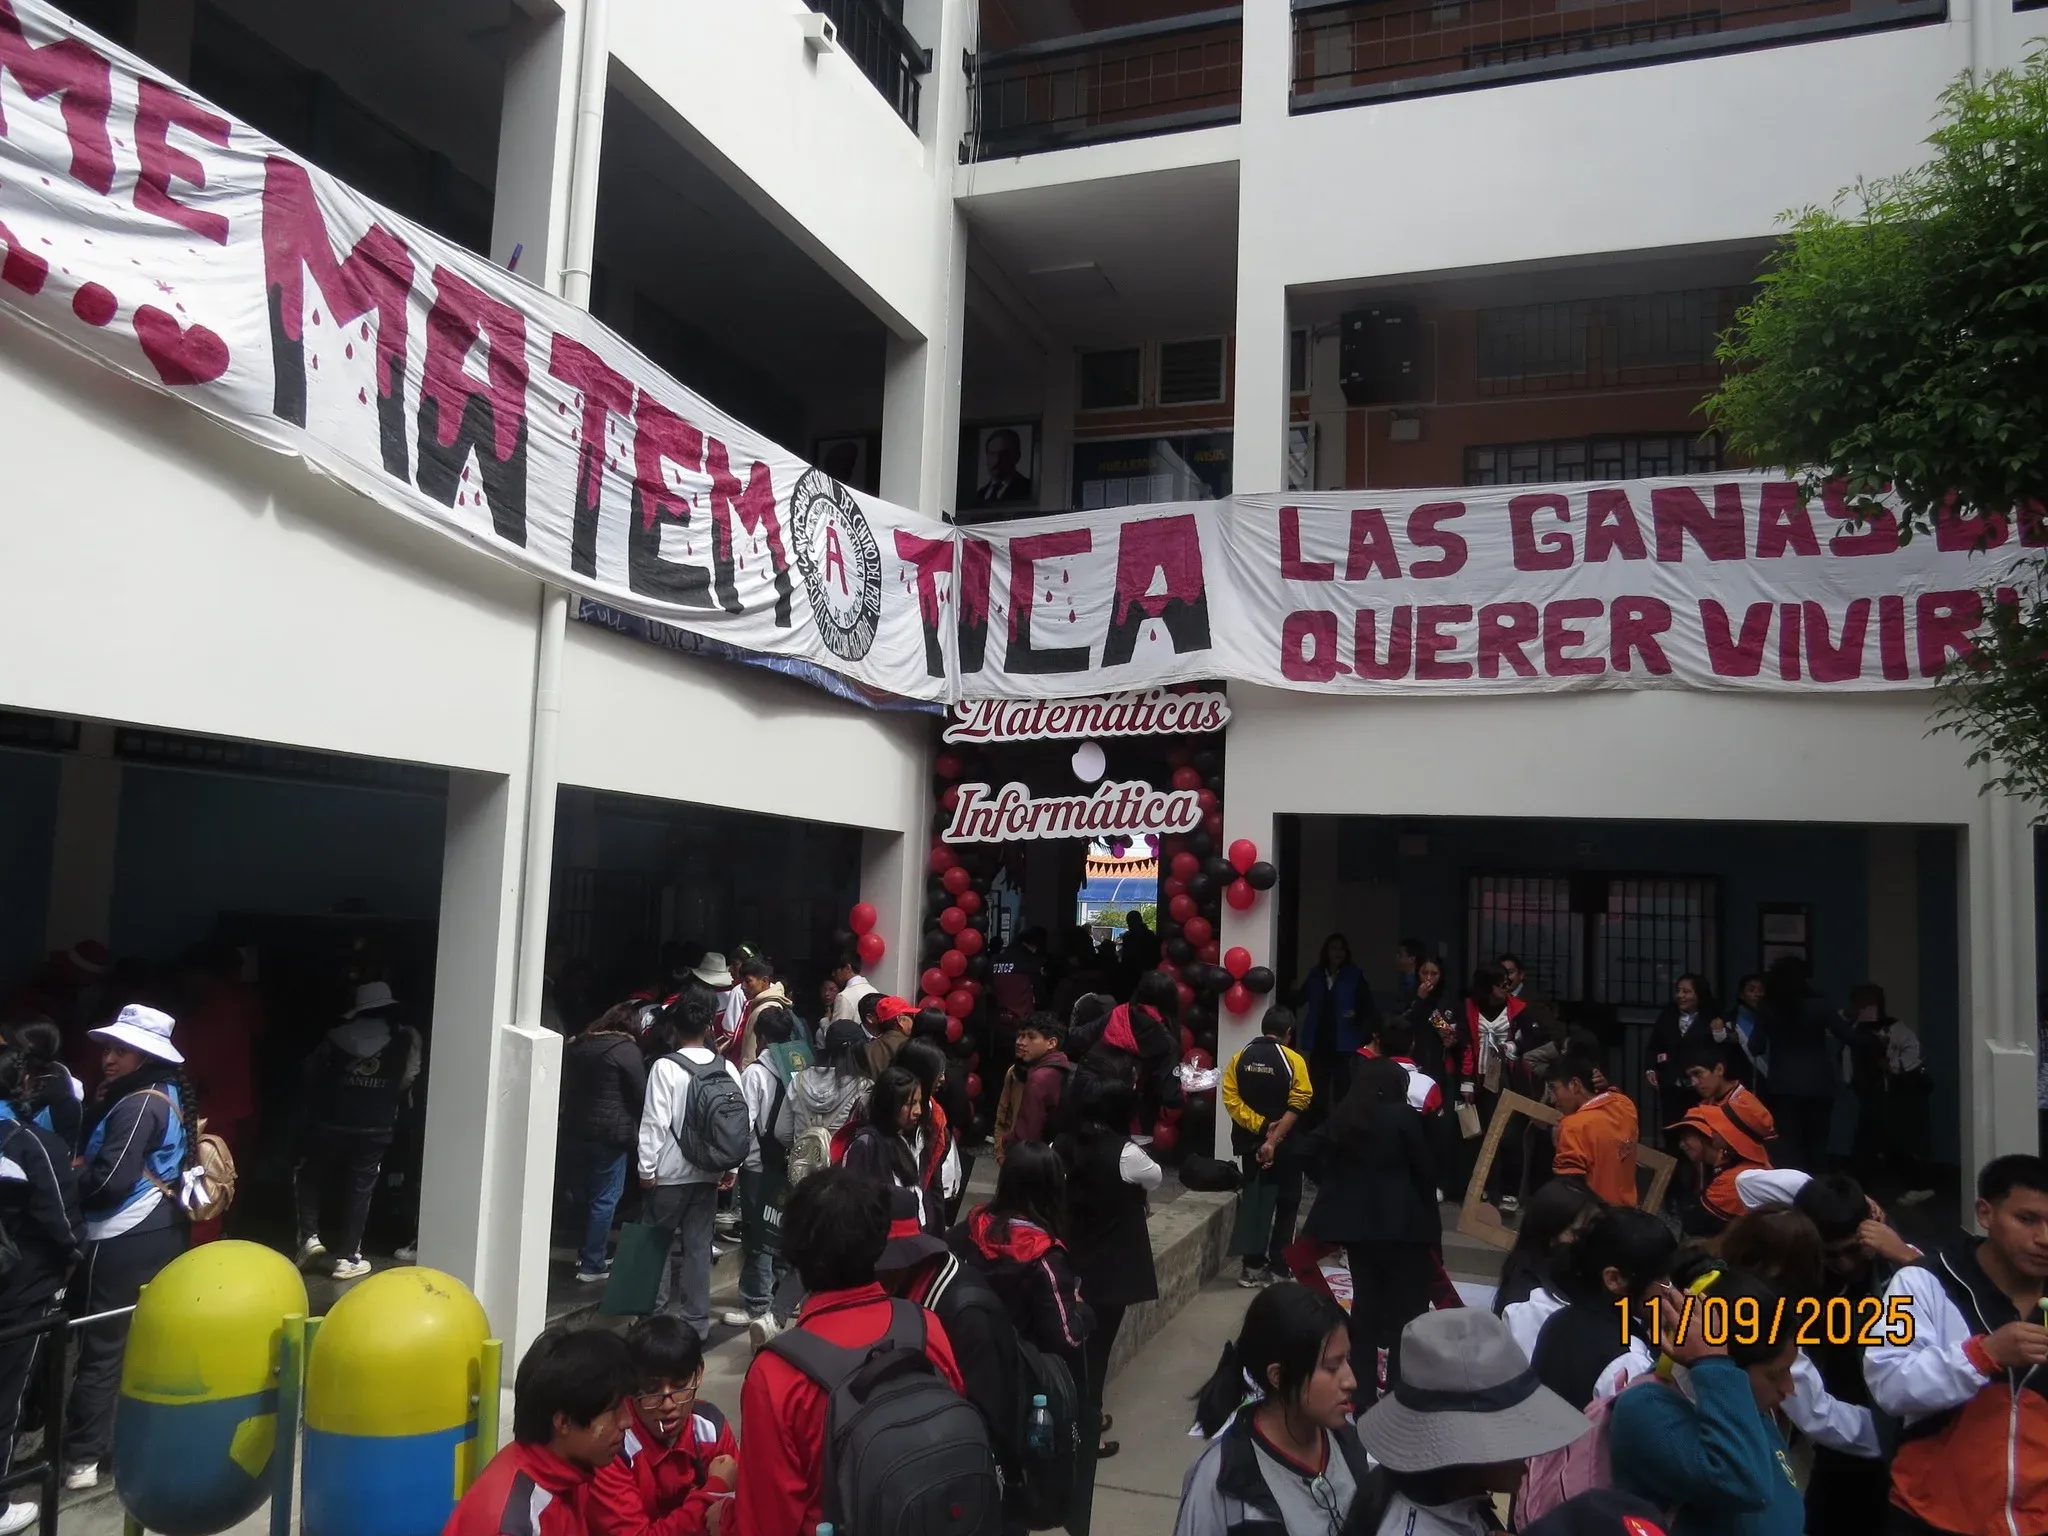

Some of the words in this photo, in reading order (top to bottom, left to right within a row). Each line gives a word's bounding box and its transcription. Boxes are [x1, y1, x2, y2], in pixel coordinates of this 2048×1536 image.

[852, 514, 878, 560] CENTRO
[865, 560, 880, 582] DEL
[1279, 501, 1468, 581] LAS
[1508, 475, 1899, 571] GANAS
[580, 602, 627, 631] FULL
[647, 620, 704, 653] UNCP
[1280, 595, 1672, 683] QUERER
[947, 692, 1226, 738] Matemáticas
[947, 785, 1199, 839] Informática
[992, 963, 1015, 974] UNCP
